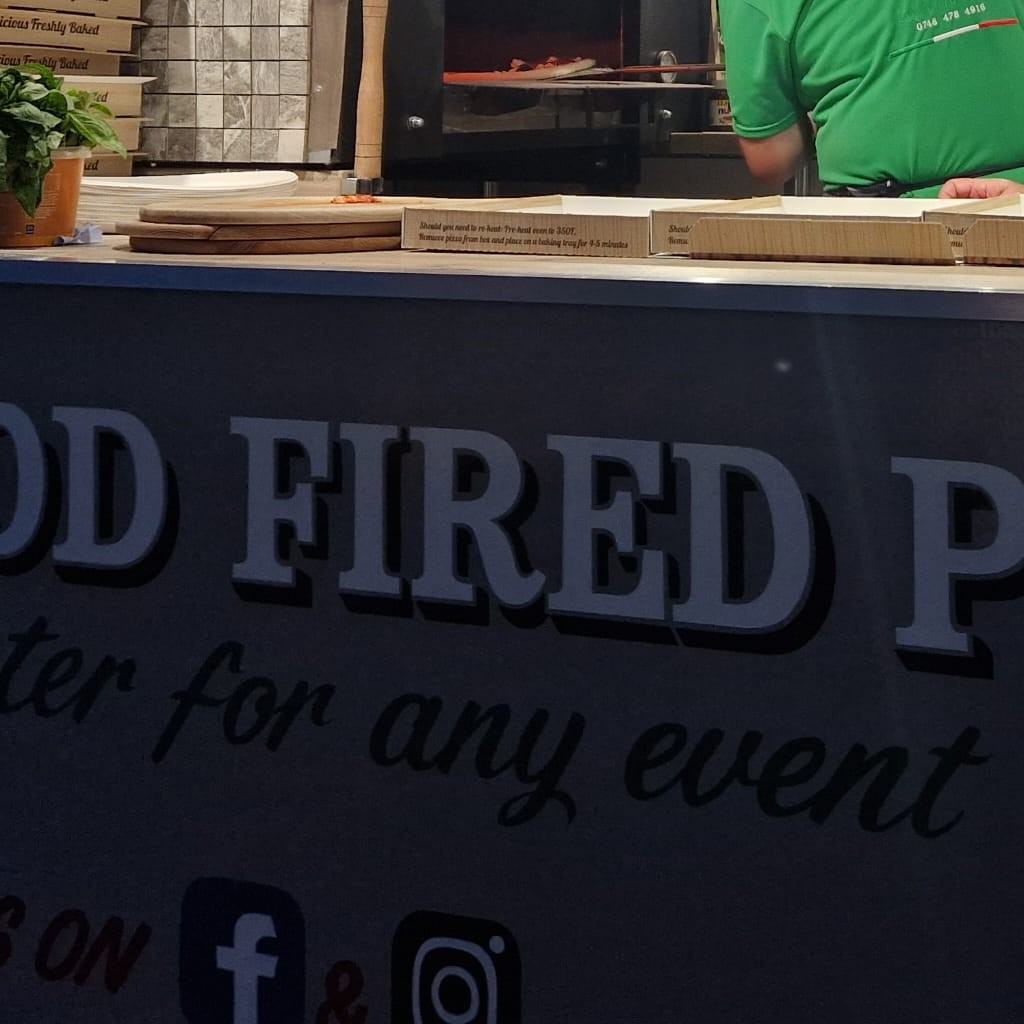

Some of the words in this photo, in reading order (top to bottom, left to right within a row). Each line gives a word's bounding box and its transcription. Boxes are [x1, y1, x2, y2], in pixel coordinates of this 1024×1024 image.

[964, 3, 986, 15] 4916
[31, 18, 66, 36] Freshly
[69, 22, 100, 35] Baked
[60, 56, 88, 69] Baked
[420, 222, 441, 230] Should
[549, 227, 555, 235] to
[419, 233, 444, 242] Remove
[445, 235, 462, 243] pizza
[462, 235, 478, 244] from
[491, 236, 504, 244] and
[505, 237, 522, 245] place
[538, 238, 561, 248] baking
[562, 239, 576, 249] tray
[576, 239, 588, 249] for
[601, 240, 628, 248] minutes
[230, 416, 826, 644] FIRED
[151, 640, 334, 762] for
[369, 692, 586, 826] any
[623, 722, 994, 838] event
[35, 909, 152, 993] ON
